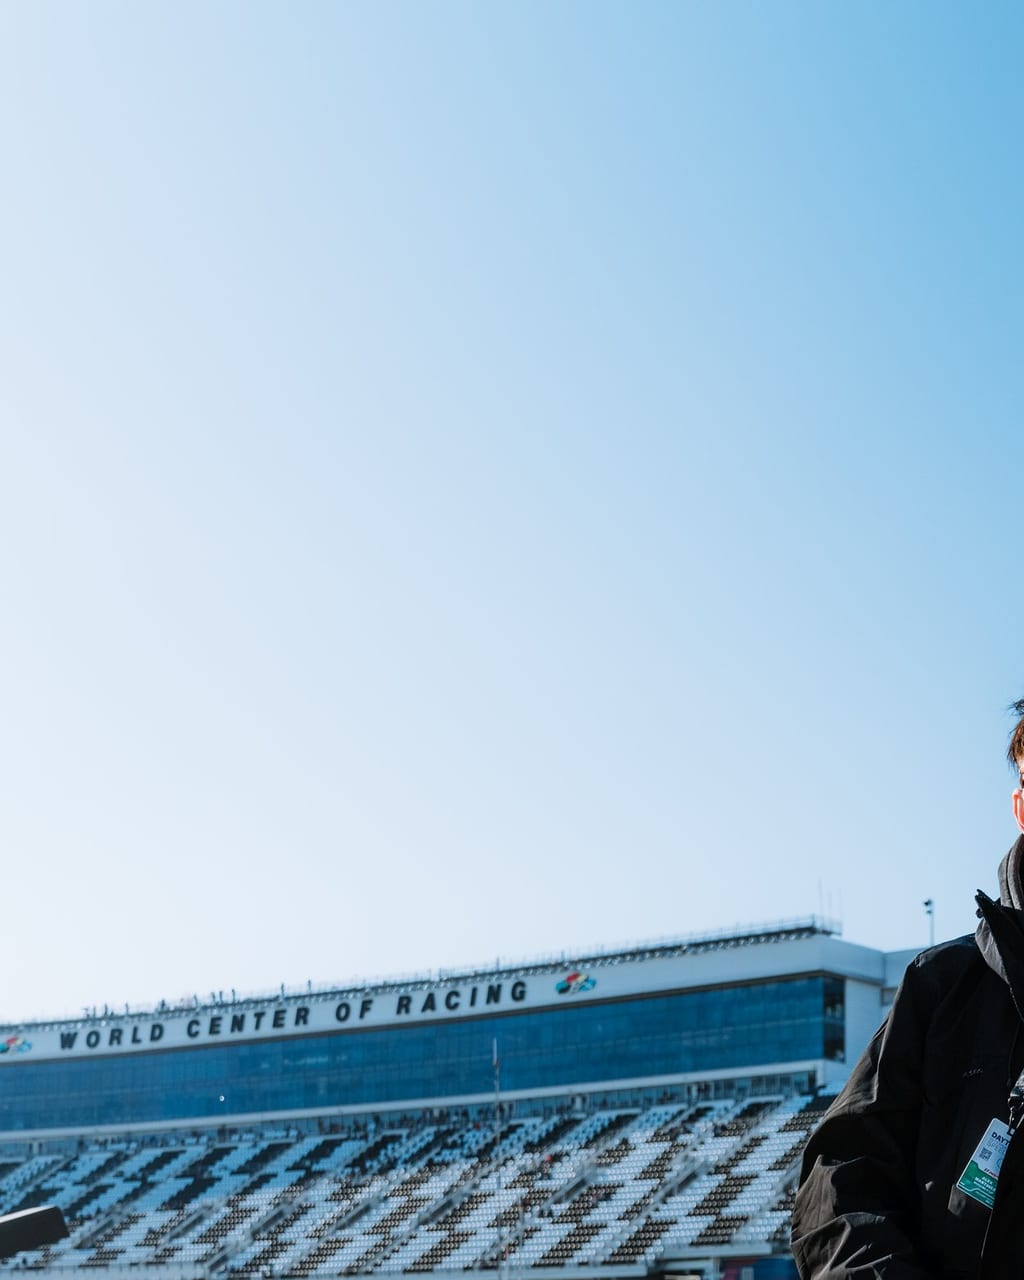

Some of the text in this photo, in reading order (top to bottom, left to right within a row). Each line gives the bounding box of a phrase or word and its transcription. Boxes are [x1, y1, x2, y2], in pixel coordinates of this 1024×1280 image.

[59, 980, 527, 1051] WORLD CENTER OF RACING
